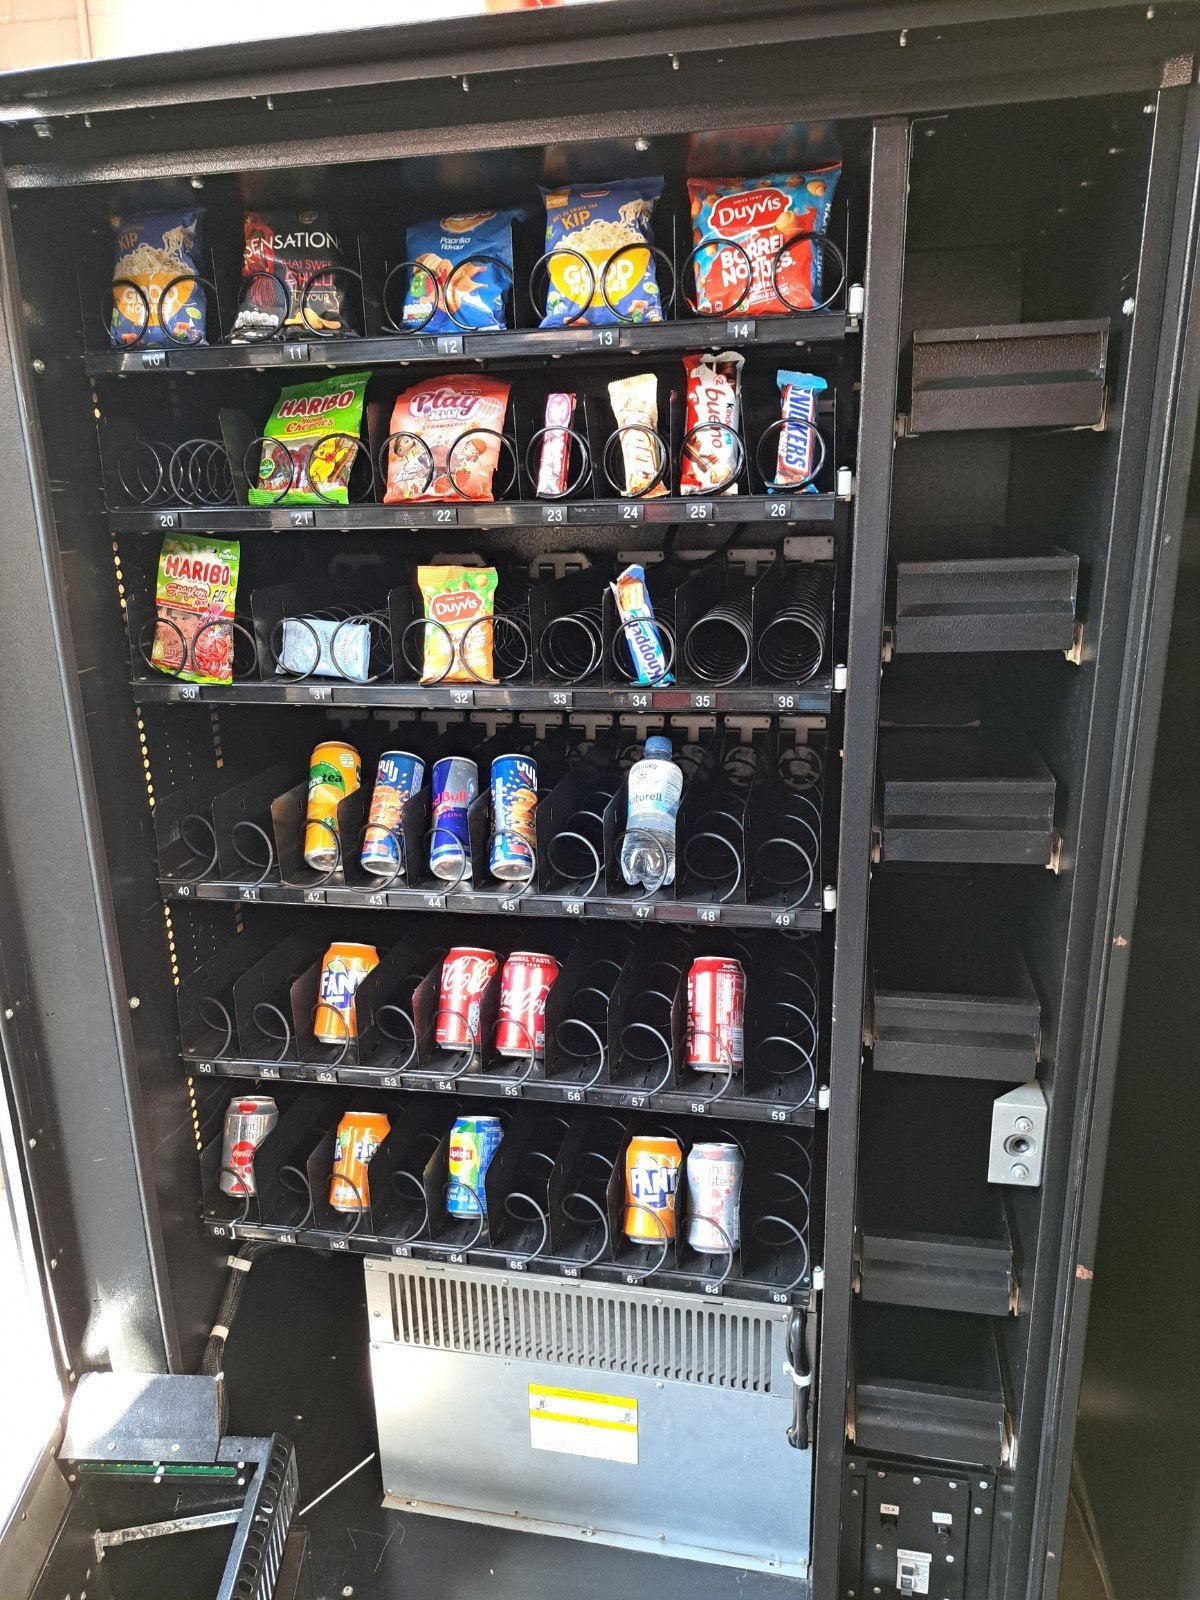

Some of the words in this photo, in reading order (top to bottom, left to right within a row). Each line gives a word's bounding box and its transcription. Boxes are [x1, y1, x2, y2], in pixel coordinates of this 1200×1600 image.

[717, 195, 782, 226] Duyvis
[561, 210, 591, 230] KIP
[118, 232, 138, 252] KIP
[563, 259, 635, 285] GOOD
[122, 284, 179, 305] GOOD
[290, 293, 330, 302] FLVOUR
[733, 324, 749, 338] 14
[597, 332, 613, 345] 13
[442, 340, 458, 353] 12
[288, 347, 303, 360] 11
[147, 354, 160, 366] 10
[277, 389, 355, 418] HARIBO
[411, 389, 480, 416] Play
[428, 409, 460, 421] JELLY
[704, 387, 726, 449] bueno
[725, 402, 735, 429] Kinde
[547, 509, 563, 522] 23
[623, 506, 639, 518] 24
[690, 506, 707, 518] 25
[770, 504, 786, 516] 26
[160, 515, 174, 527] 20
[295, 514, 309, 525] 21
[437, 510, 451, 522] 22
[164, 554, 231, 588] HARIBO
[435, 596, 478, 618] Duyvis
[183, 687, 196, 698] 30
[313, 690, 326, 700] 31
[454, 692, 469, 704] 32
[553, 693, 567, 705] 33
[632, 695, 648, 707] 34
[695, 695, 710, 707] 35
[778, 695, 794, 708] 36
[178, 886, 190, 896] 40
[243, 889, 257, 900] 41
[308, 892, 320, 902] 42
[369, 895, 383, 905] 43
[428, 899, 441, 908] 44
[501, 901, 515, 911] 45
[566, 904, 580, 914] 46
[636, 907, 650, 918] 47
[701, 911, 716, 922] 48
[775, 915, 790, 926] 49
[321, 970, 369, 996] FANT
[200, 1064, 211, 1073] 50
[263, 1068, 274, 1077] 51
[320, 1073, 332, 1082] 52
[384, 1077, 397, 1087] 53
[439, 1081, 452, 1091] 54
[505, 1086, 518, 1096] 55
[567, 1091, 581, 1101] 56
[631, 1097, 645, 1107] 57
[691, 1103, 705, 1114] 58
[771, 1111, 786, 1121] 59
[630, 1167, 678, 1195] FANT
[213, 1227, 225, 1236] 60
[281, 1234, 293, 1243] 61
[395, 1247, 408, 1256] 63
[450, 1254, 463, 1263] 64
[510, 1260, 523, 1270] 65
[773, 1292, 787, 1303] 69
